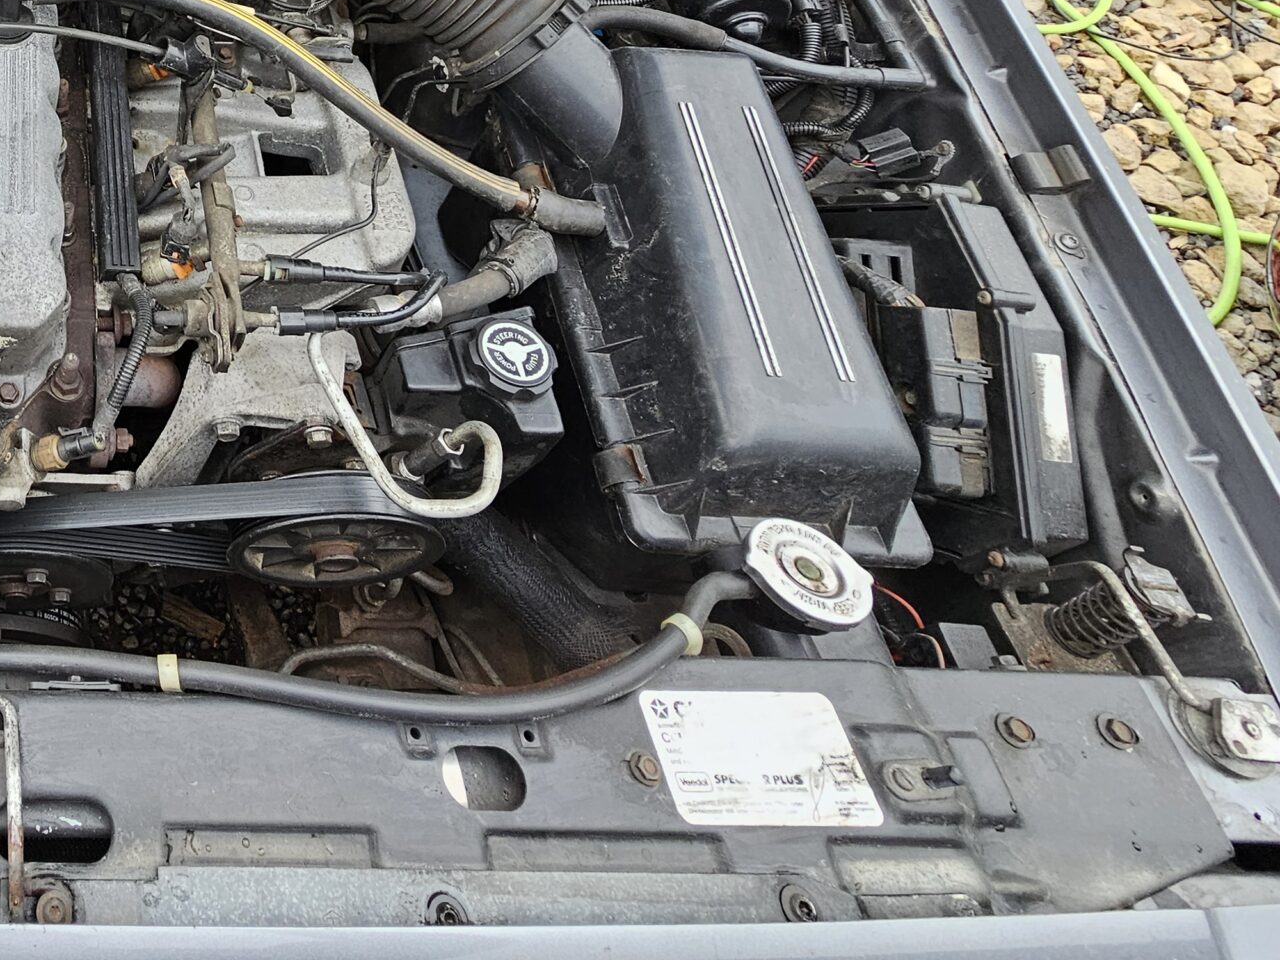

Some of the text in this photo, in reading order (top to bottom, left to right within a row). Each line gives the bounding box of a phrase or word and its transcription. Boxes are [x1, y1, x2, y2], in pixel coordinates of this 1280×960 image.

[493, 332, 528, 345] STEERING
[494, 351, 516, 372] POWER
[525, 353, 539, 371] FLUID
[773, 774, 804, 785] PLUS
